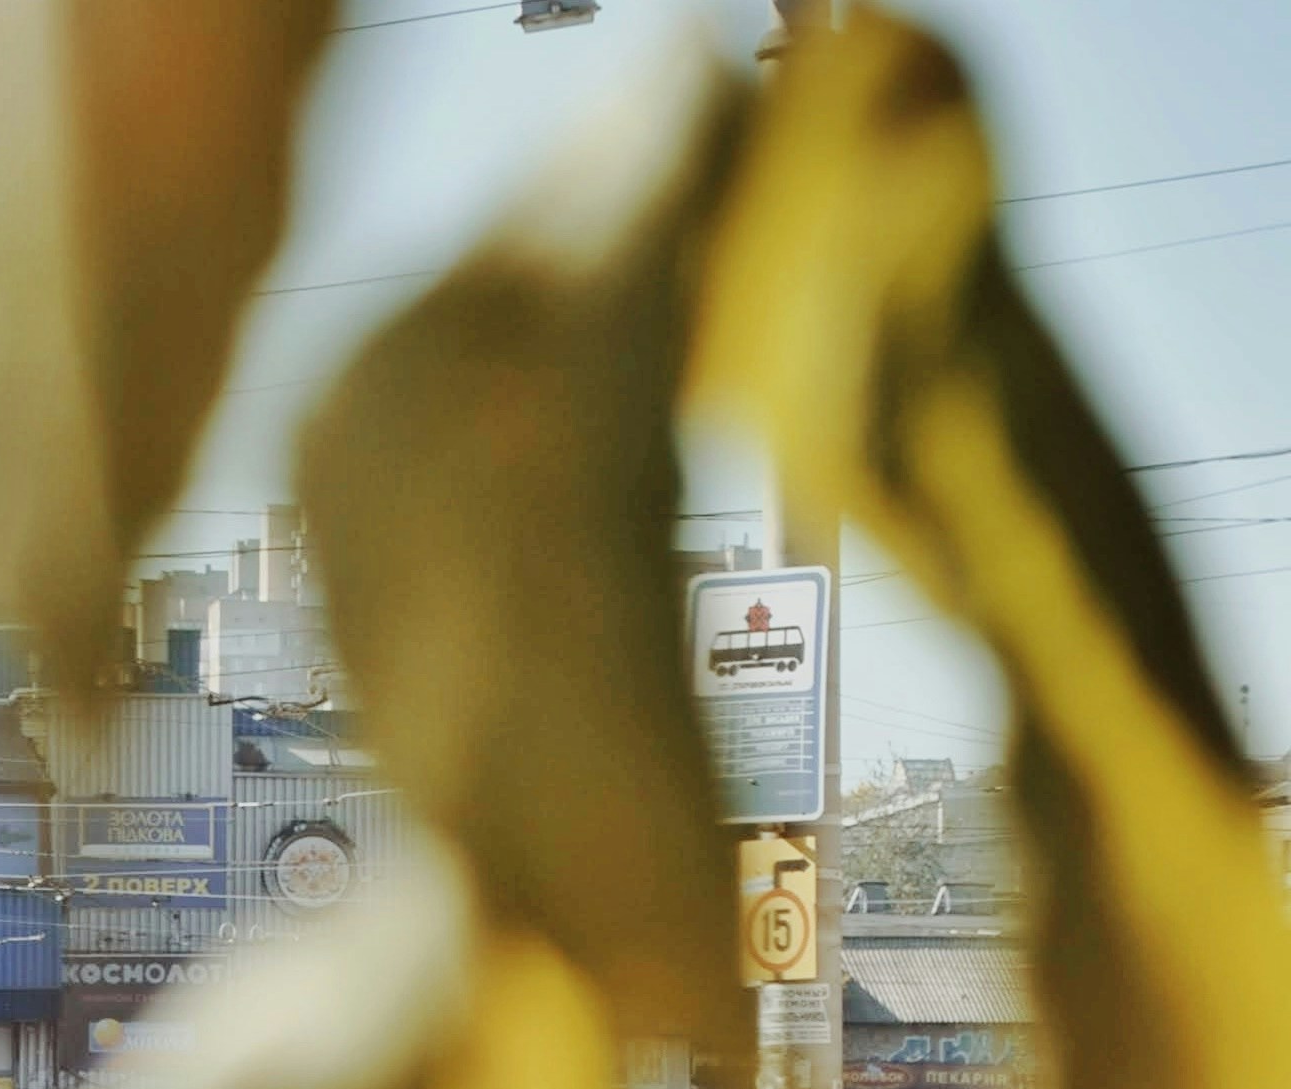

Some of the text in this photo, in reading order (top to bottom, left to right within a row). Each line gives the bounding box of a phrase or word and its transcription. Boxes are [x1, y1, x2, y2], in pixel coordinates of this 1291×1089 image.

[108, 811, 185, 826] ЗОЛОТА
[107, 827, 185, 842] ПІДКОВА
[83, 876, 210, 895] 2 ПОВЕРХ
[761, 909, 792, 952] 15
[60, 962, 224, 984] КОСМОЛОТ
[925, 1070, 1007, 1086] ПЕКАРНЯ
